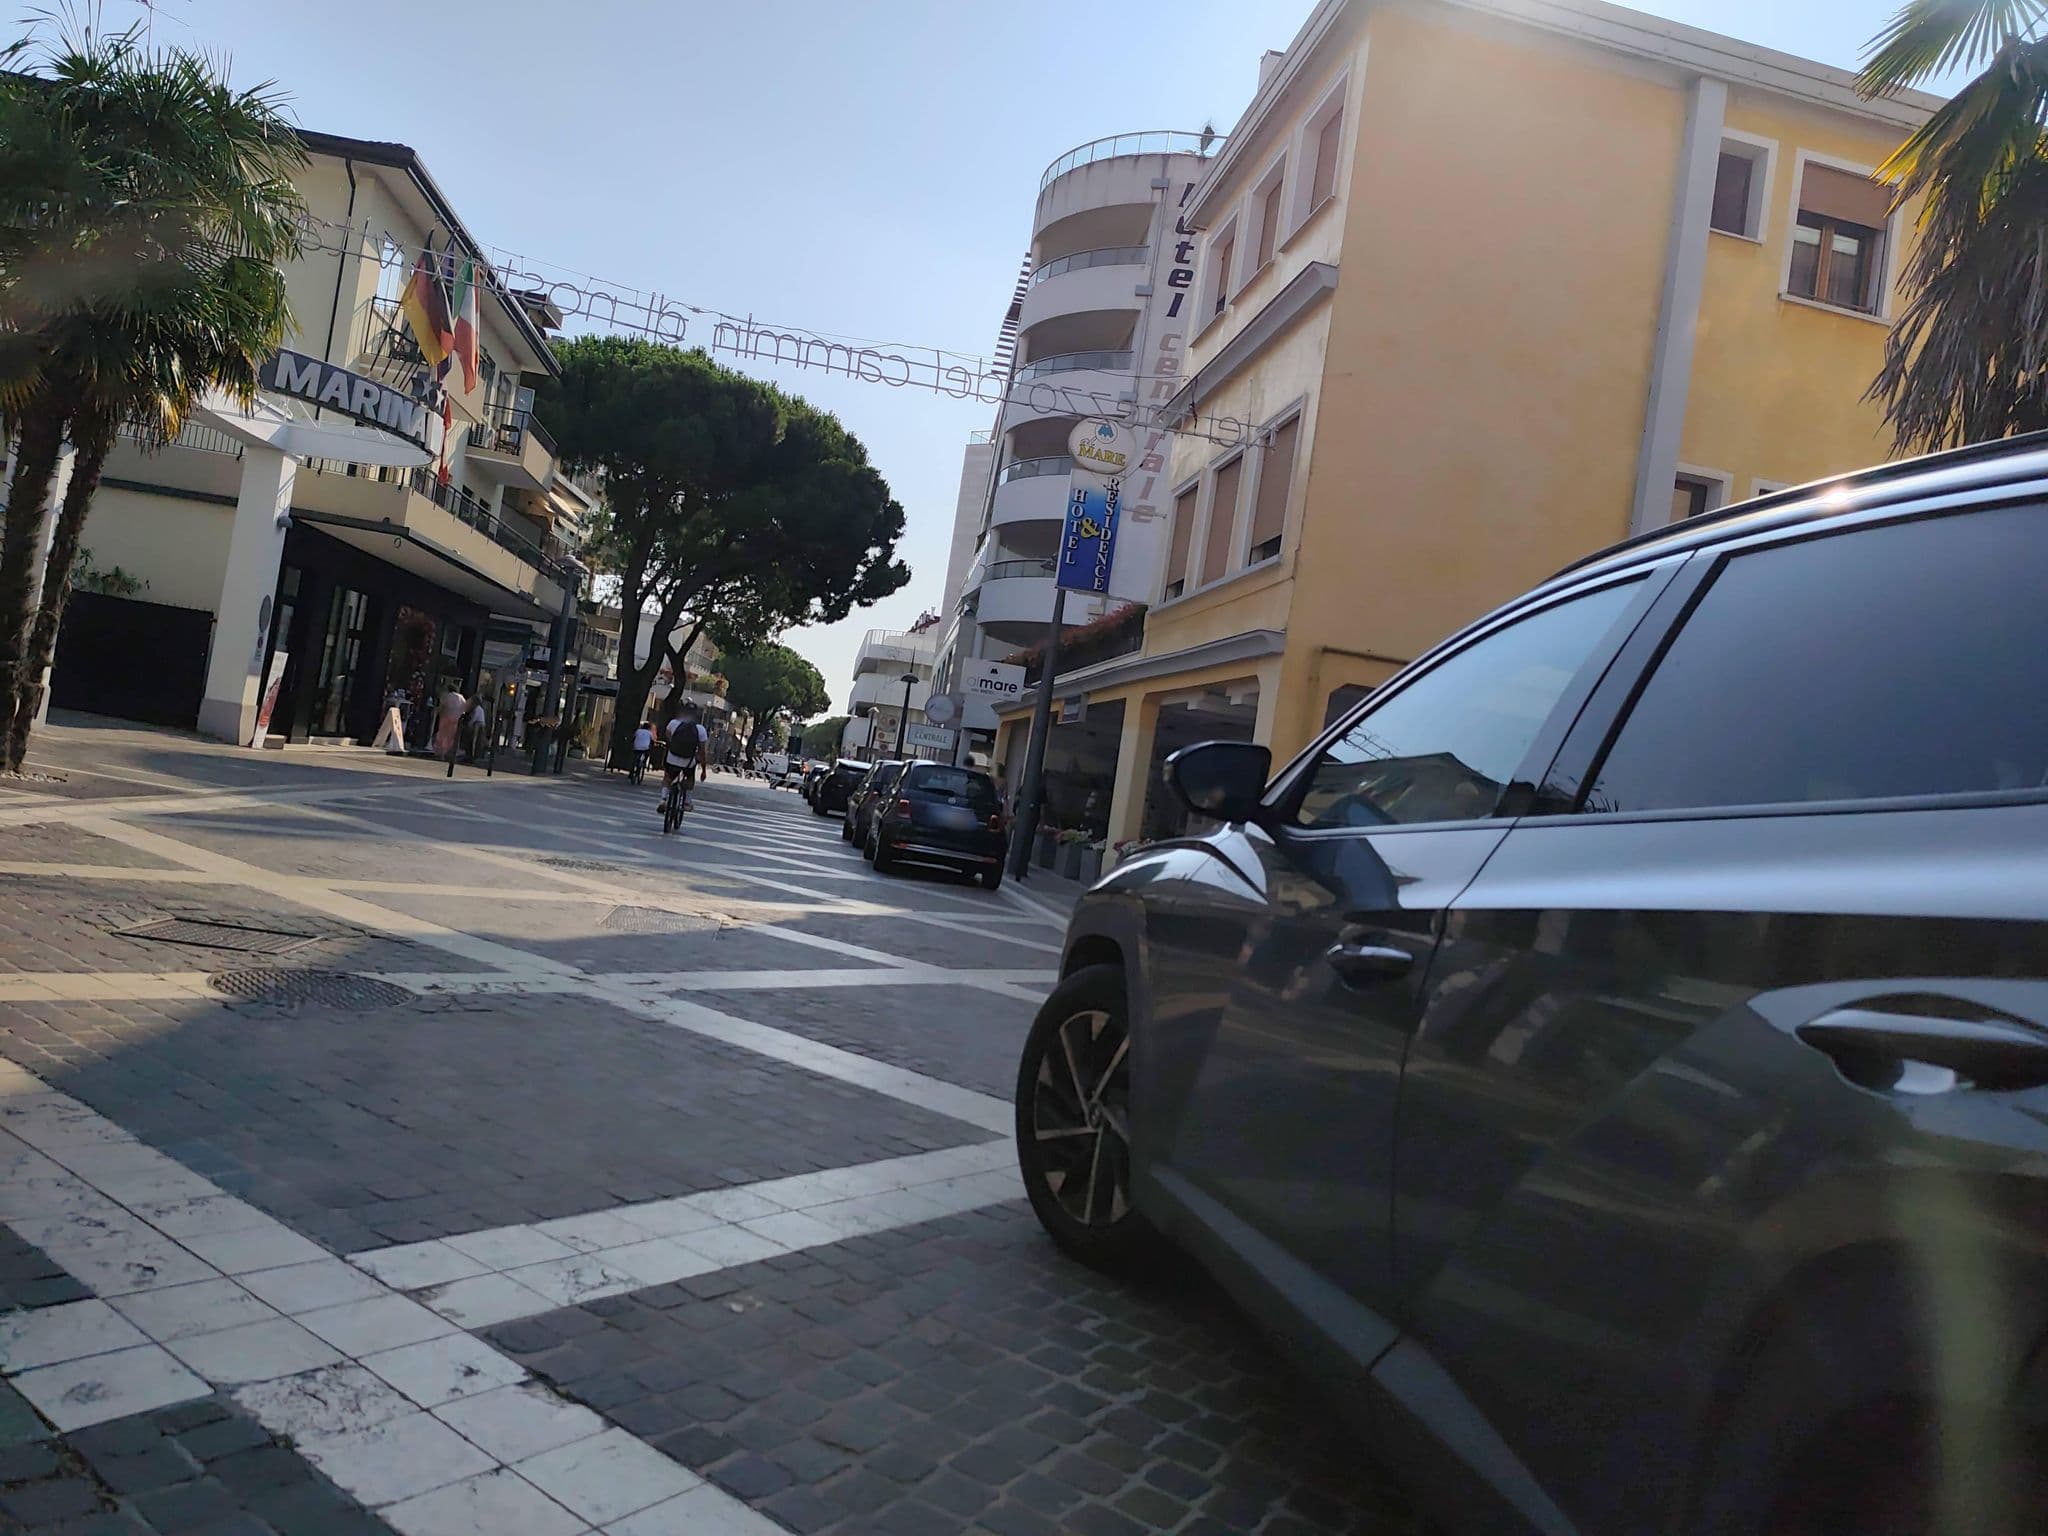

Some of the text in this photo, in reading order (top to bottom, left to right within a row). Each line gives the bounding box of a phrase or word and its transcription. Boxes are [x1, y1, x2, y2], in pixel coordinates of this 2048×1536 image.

[274, 352, 427, 443] MARINA
[1077, 443, 1127, 467] MARE
[1065, 488, 1088, 565] HOTEL
[1080, 516, 1100, 539] &
[1093, 476, 1120, 591] RESIDENCE
